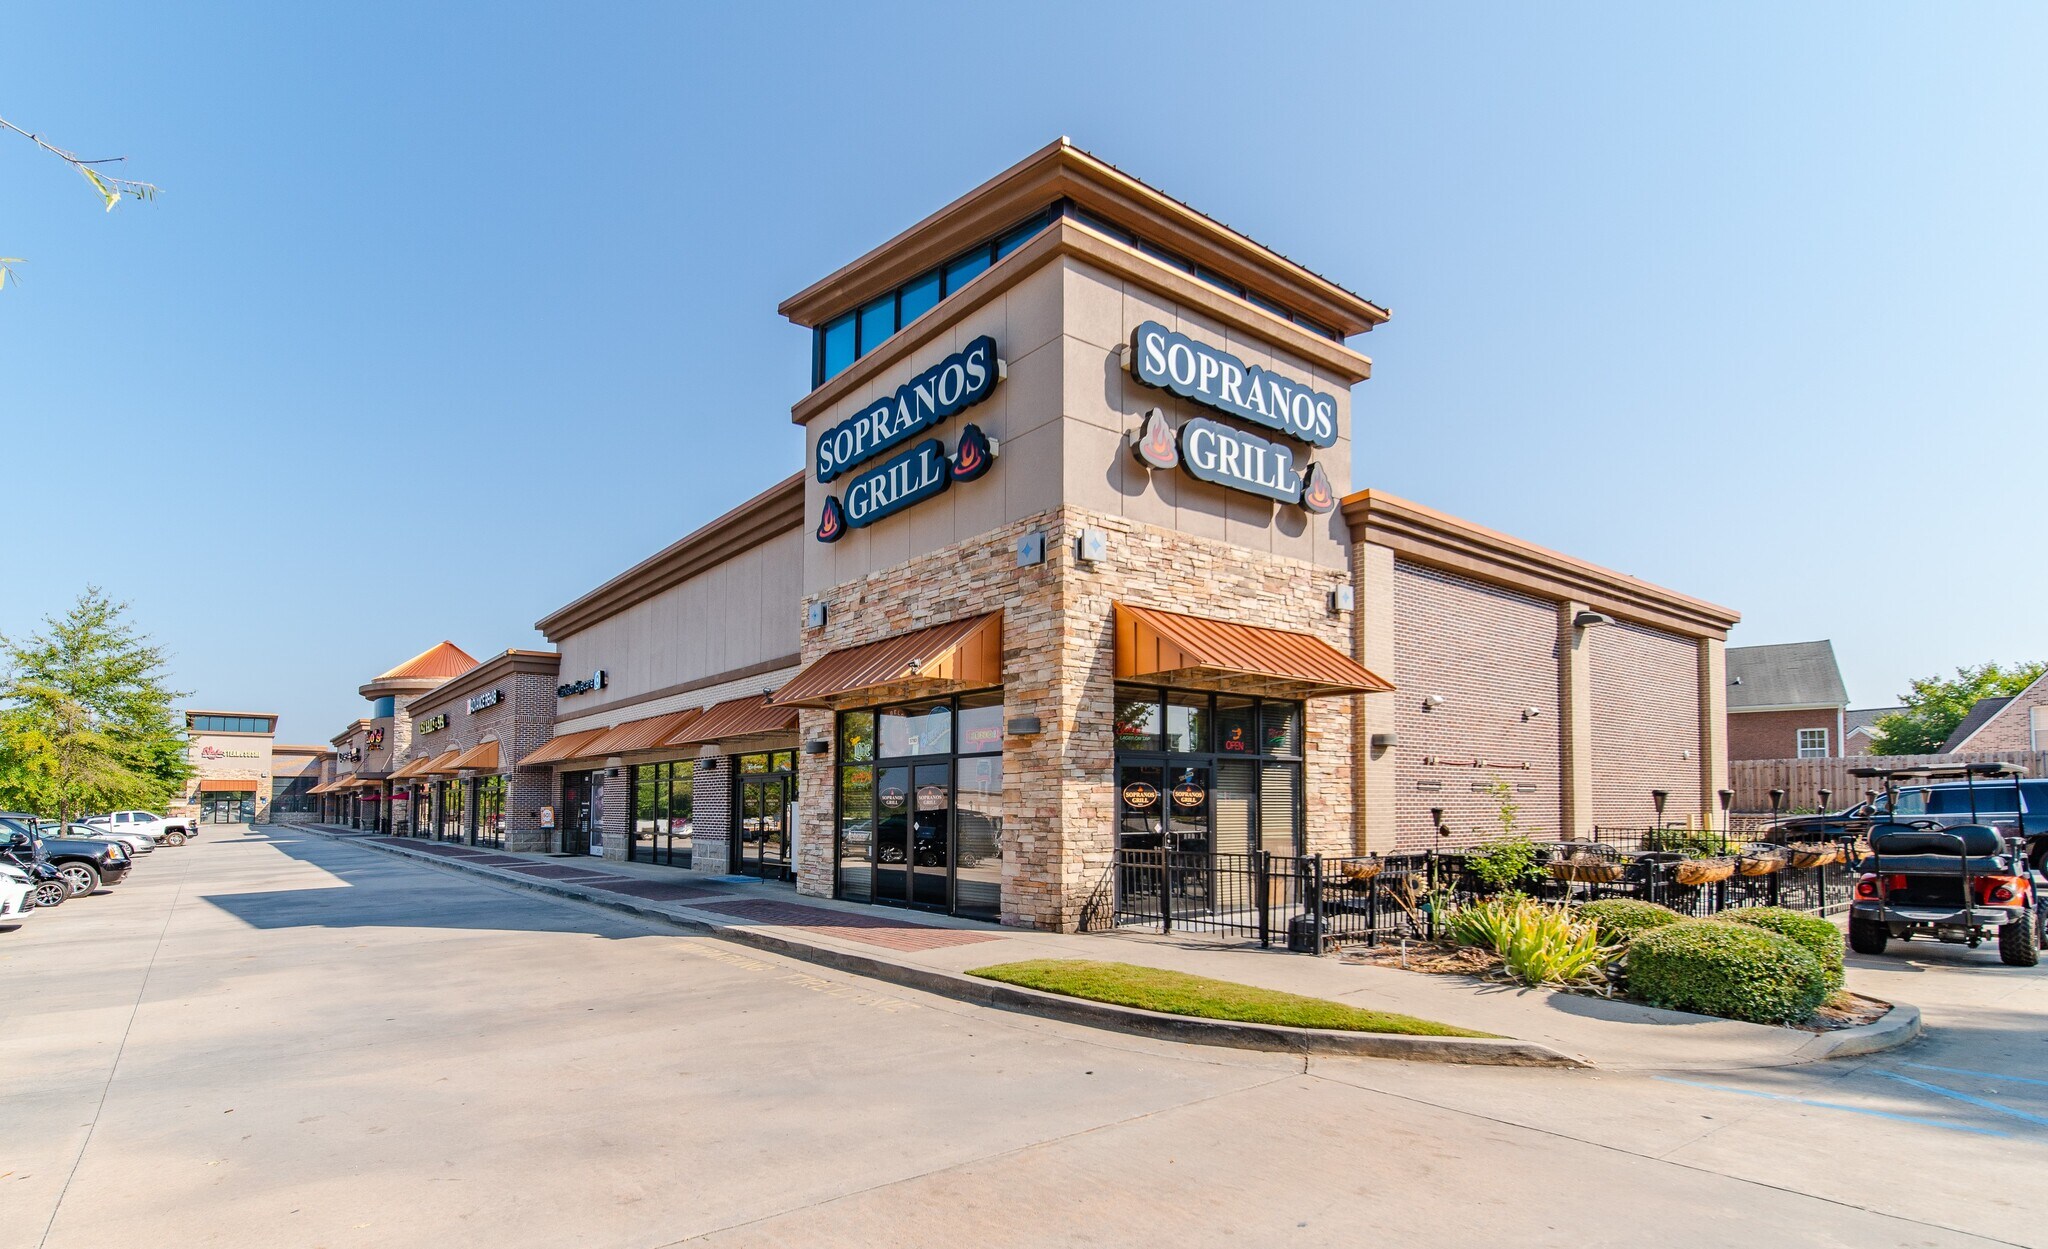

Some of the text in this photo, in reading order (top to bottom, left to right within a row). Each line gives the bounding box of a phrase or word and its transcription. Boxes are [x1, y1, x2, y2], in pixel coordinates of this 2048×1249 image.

[820, 347, 986, 474] SOPRANOS
[1145, 332, 1332, 439] SOPRANOS
[849, 449, 940, 519] GRILL
[1189, 428, 1295, 493] GRILL
[1225, 740, 1245, 751] OPEN
